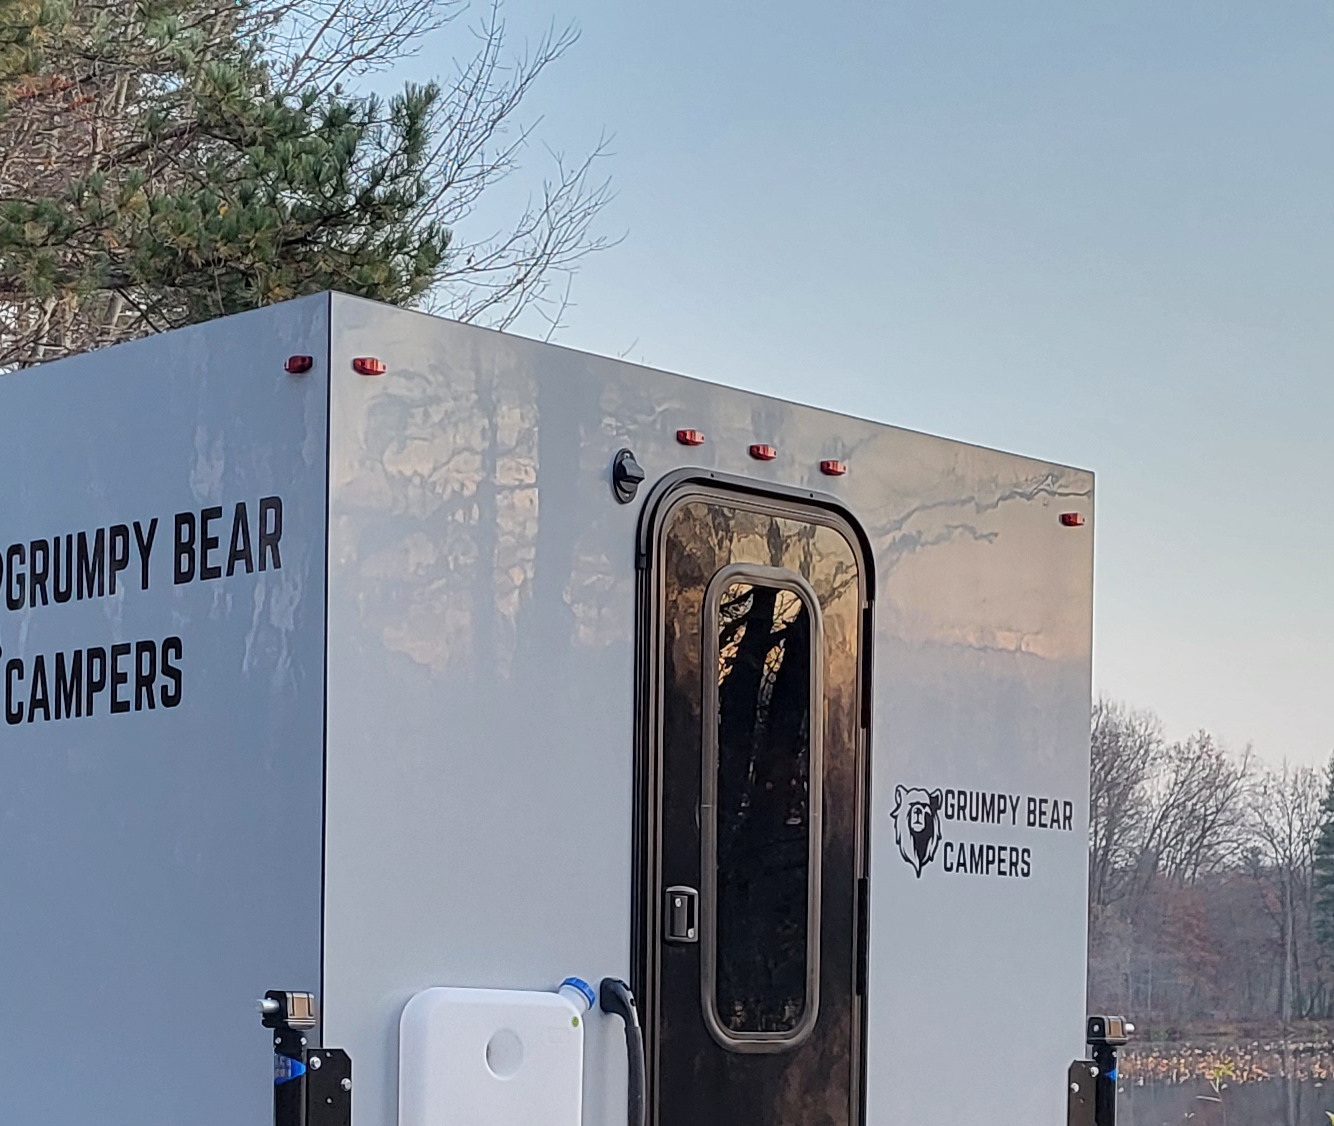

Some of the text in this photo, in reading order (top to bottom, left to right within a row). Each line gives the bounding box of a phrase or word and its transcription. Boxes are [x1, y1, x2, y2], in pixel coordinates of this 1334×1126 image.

[6, 495, 283, 611] GRUMPY BEAR
[4, 636, 183, 725] CAMPERS
[944, 789, 1073, 831] GRUMPY BEAR
[943, 842, 1031, 877] CAMPERS
